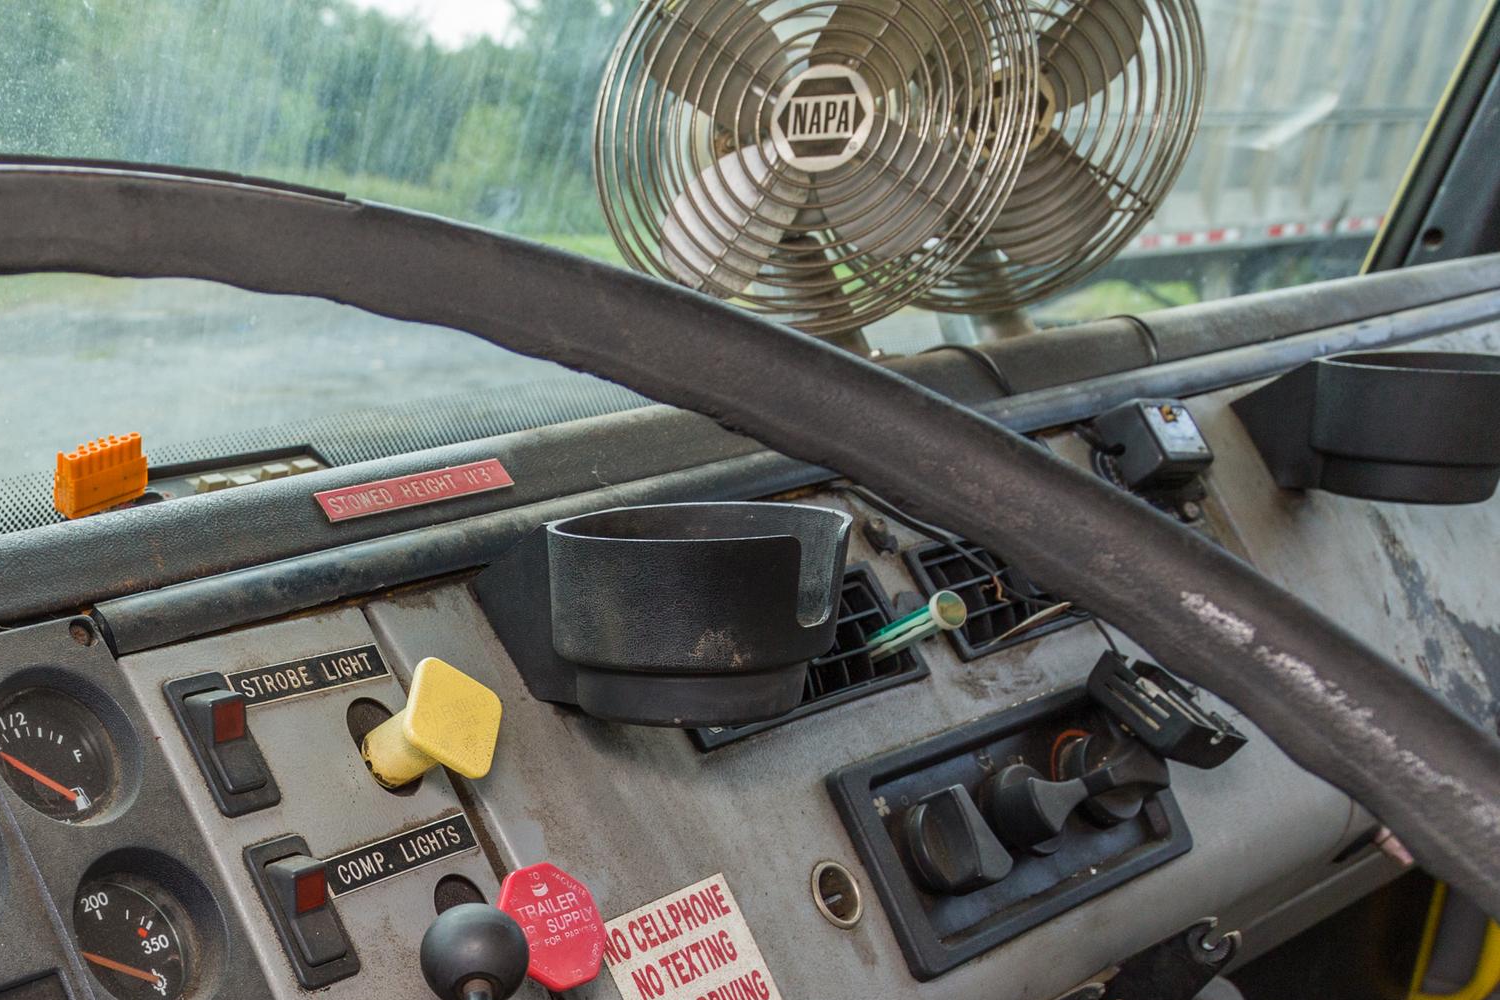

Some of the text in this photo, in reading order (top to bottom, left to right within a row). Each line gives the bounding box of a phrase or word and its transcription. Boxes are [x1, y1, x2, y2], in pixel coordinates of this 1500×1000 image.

[792, 100, 850, 135] NAPA
[327, 488, 393, 514] STOWED
[401, 474, 457, 498] HEIGHT
[240, 652, 372, 698] STROBE LIGHT
[72, 749, 83, 763] F
[337, 825, 461, 885] COMP. LIGHTS
[80, 891, 109, 913] 200
[516, 892, 579, 921] TRAILER
[546, 906, 594, 933] SUPPLY
[603, 884, 731, 967] NO CELLPHONE
[141, 934, 169, 955] 350
[544, 935, 562, 947] FOR
[658, 930, 738, 988] TEXTING
